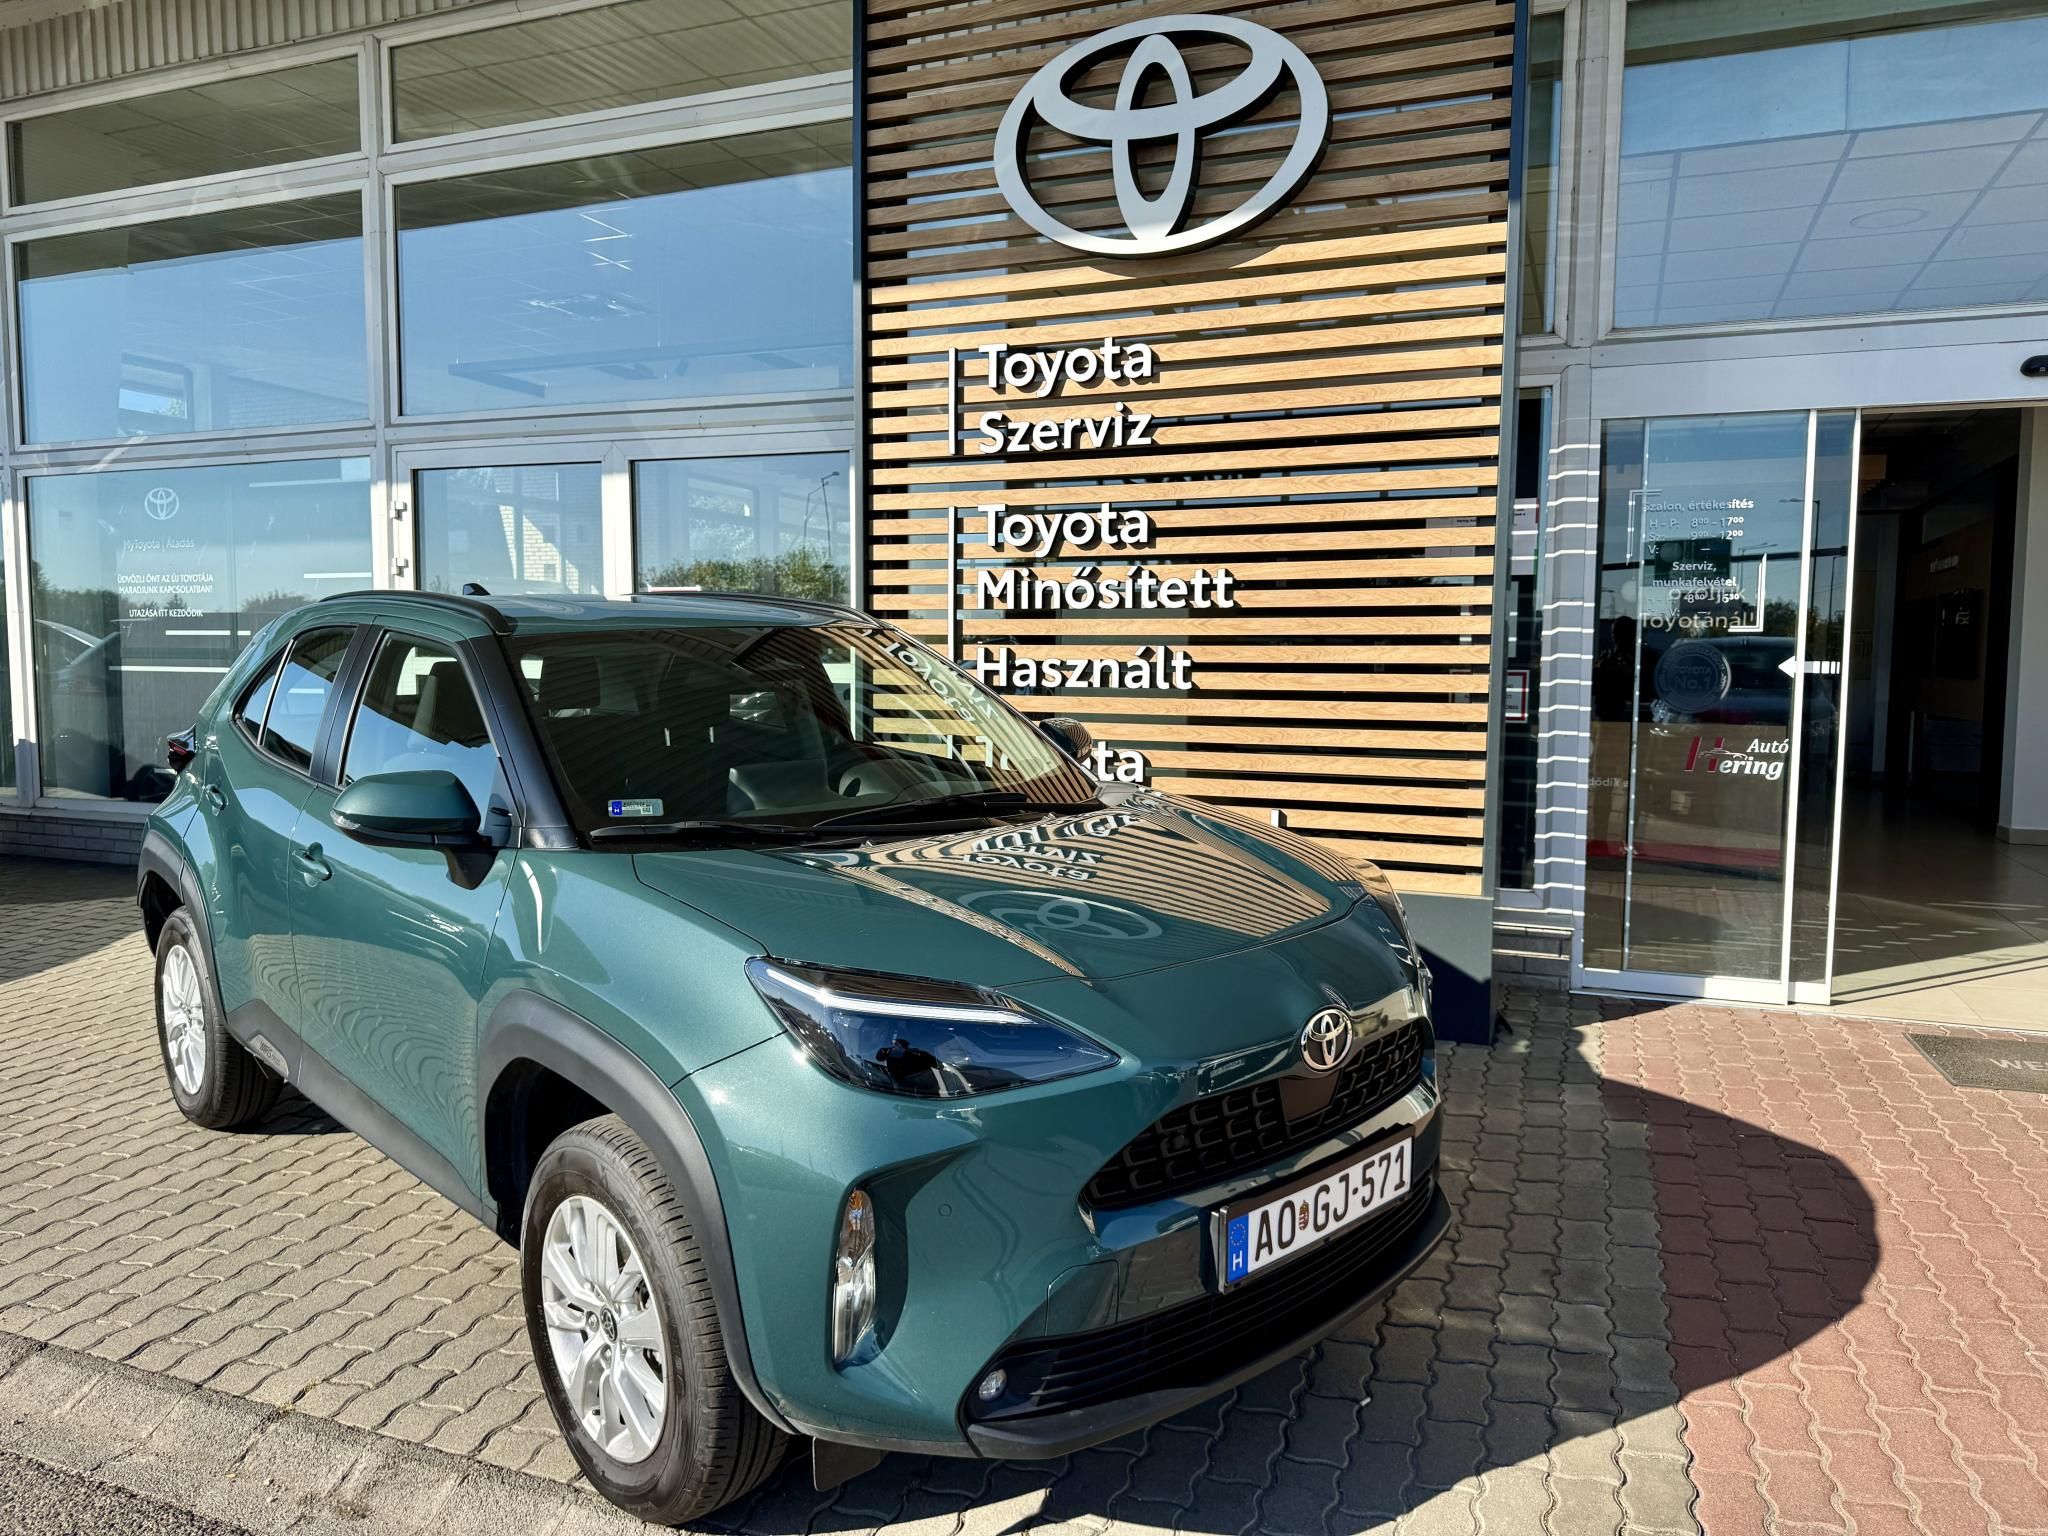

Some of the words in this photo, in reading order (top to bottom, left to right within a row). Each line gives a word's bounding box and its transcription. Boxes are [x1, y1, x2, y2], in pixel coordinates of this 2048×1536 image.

[978, 337, 1154, 397] Toyota
[977, 402, 1153, 455] Szerviz
[977, 502, 1150, 557] Toyota
[976, 565, 1235, 611] Minősített
[1652, 575, 1738, 588] munkafelvétel
[1672, 560, 1717, 573] Szerviz,
[976, 645, 1193, 690] Használt
[1747, 738, 1789, 755] Autó
[1232, 1250, 1243, 1272] H
